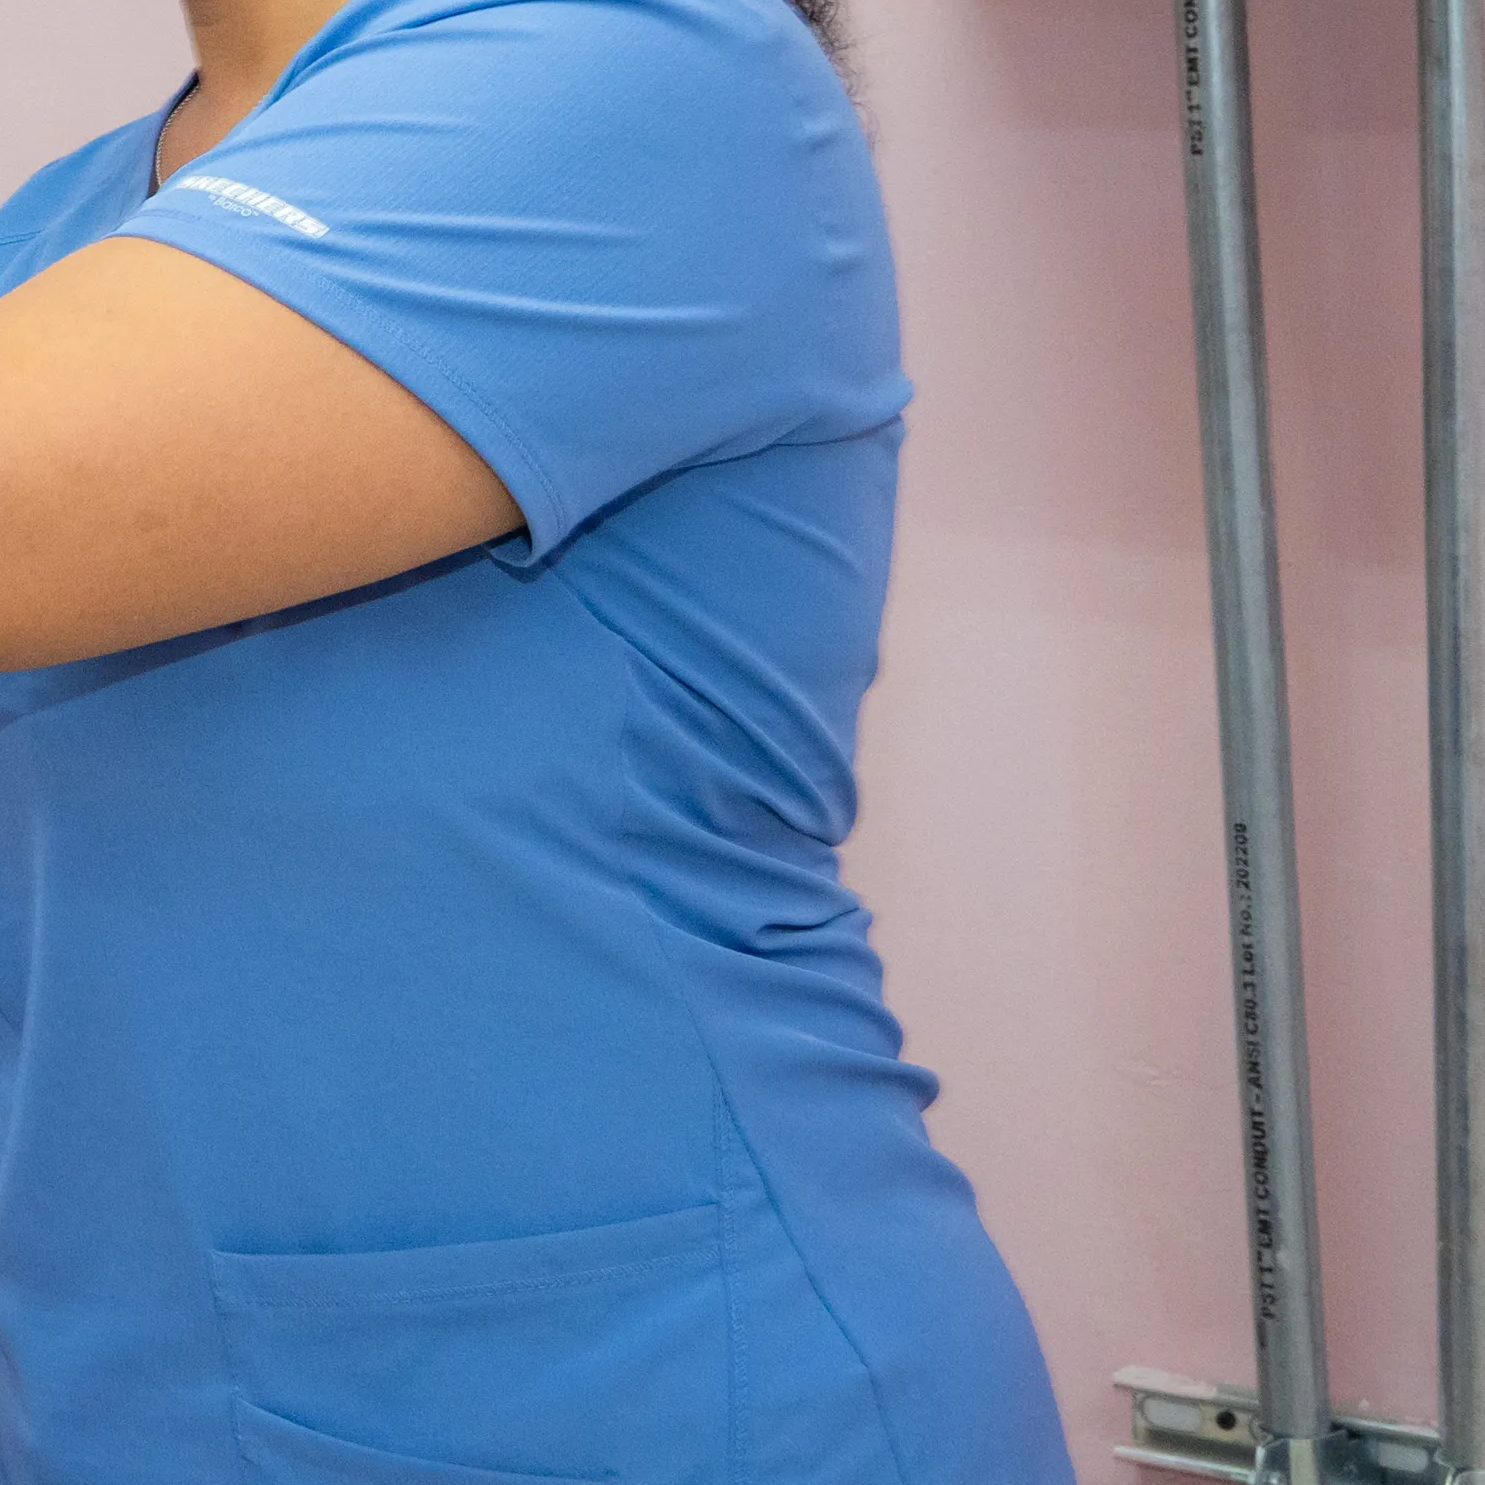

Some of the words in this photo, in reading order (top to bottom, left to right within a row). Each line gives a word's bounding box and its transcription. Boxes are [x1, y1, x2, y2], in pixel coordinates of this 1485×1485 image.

[1183, 45, 1202, 87] EMT
[1244, 1040, 1262, 1090] ANSI
[1247, 1106, 1271, 1200] CONDUIT
